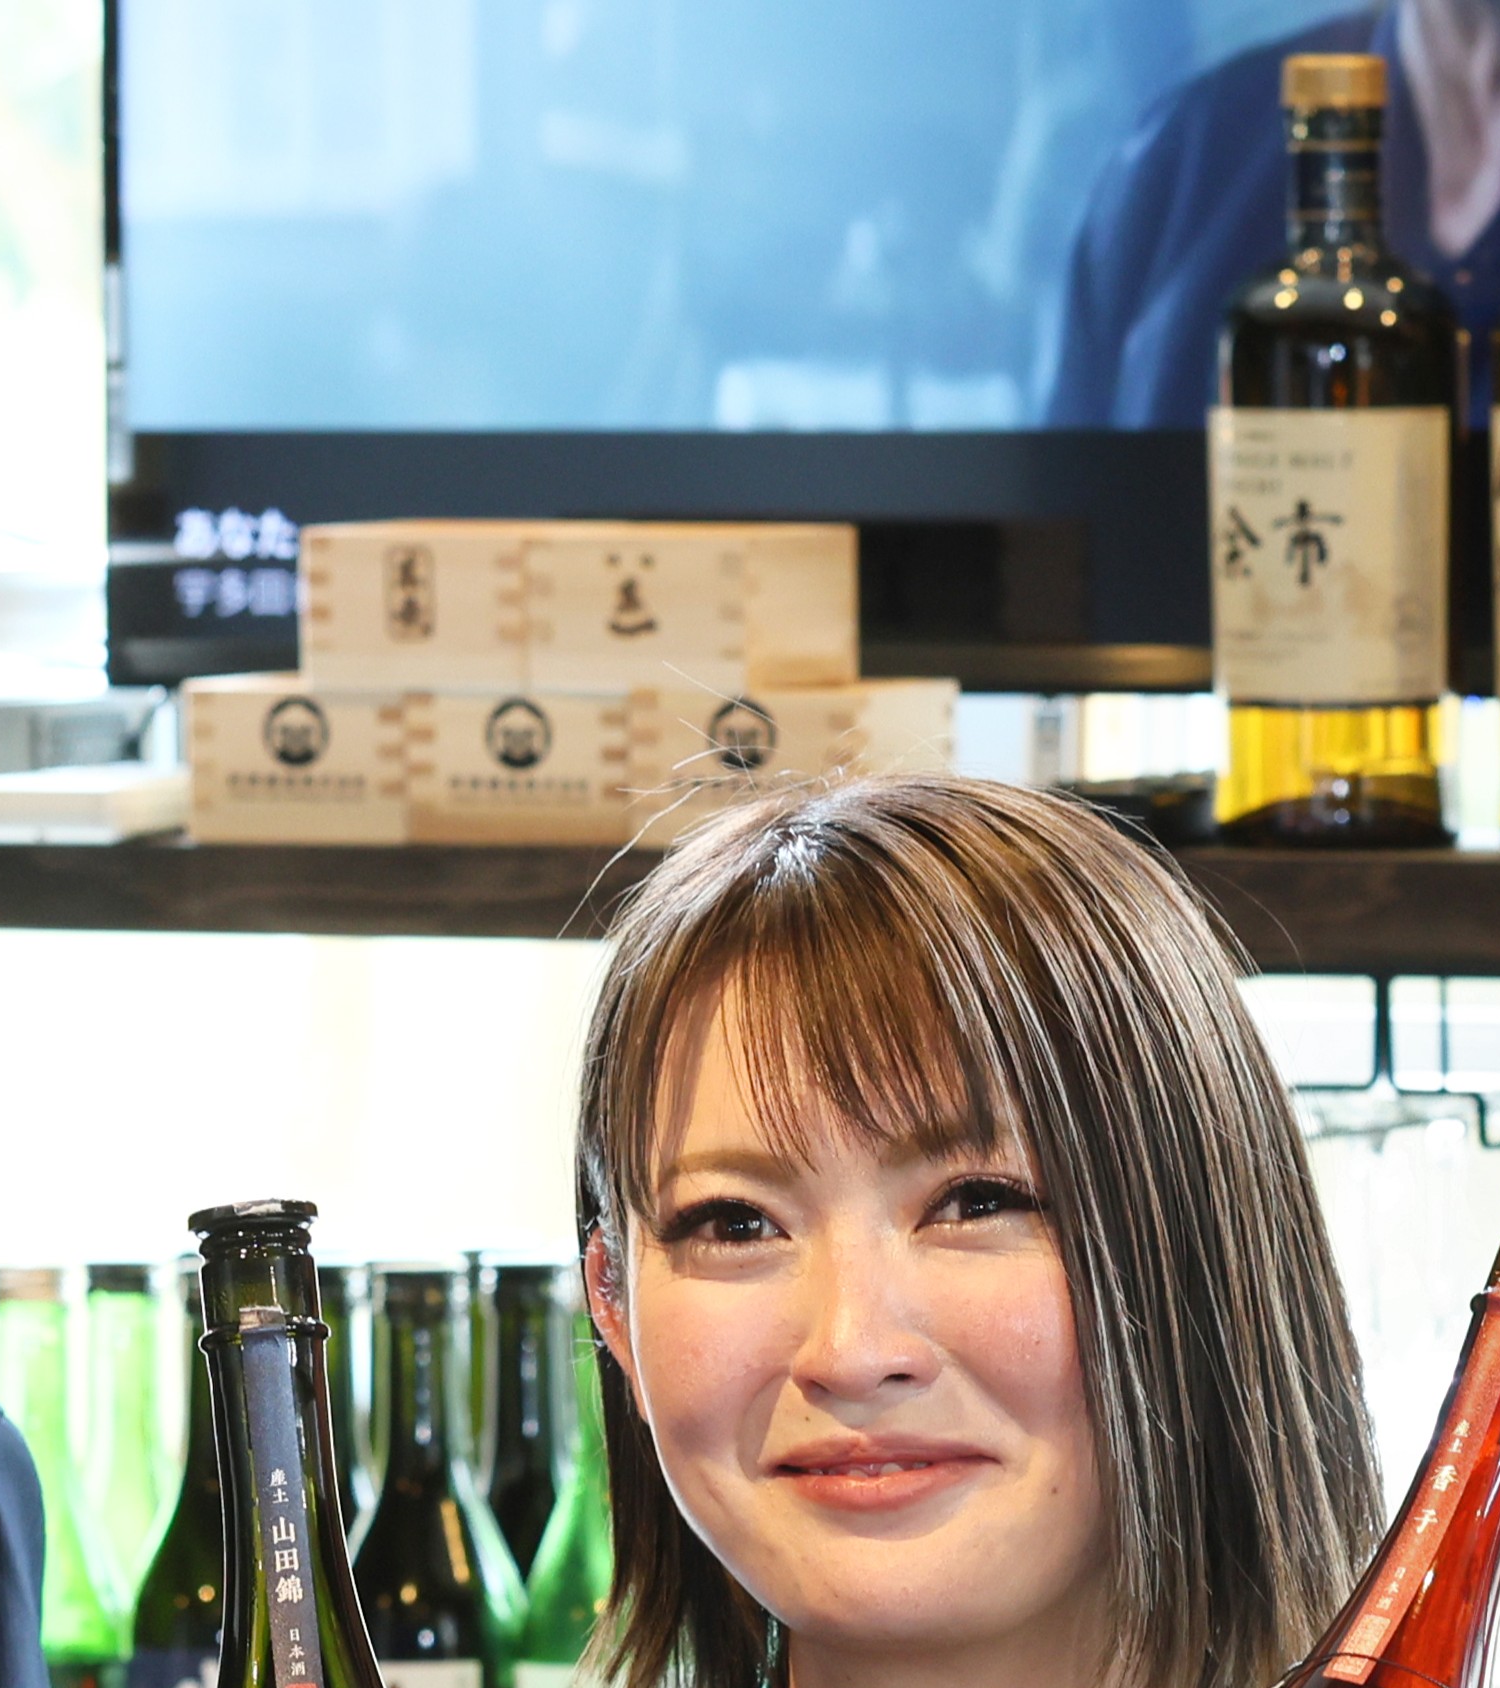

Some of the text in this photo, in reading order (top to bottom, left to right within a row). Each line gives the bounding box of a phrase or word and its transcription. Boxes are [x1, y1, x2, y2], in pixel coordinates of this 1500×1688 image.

[1451, 1418, 1472, 1455] 産土
[270, 1466, 290, 1505] 産土
[271, 1514, 303, 1605] 山田錦
[1375, 1565, 1407, 1612] 日本酒
[288, 1627, 308, 1679] 日本酒
